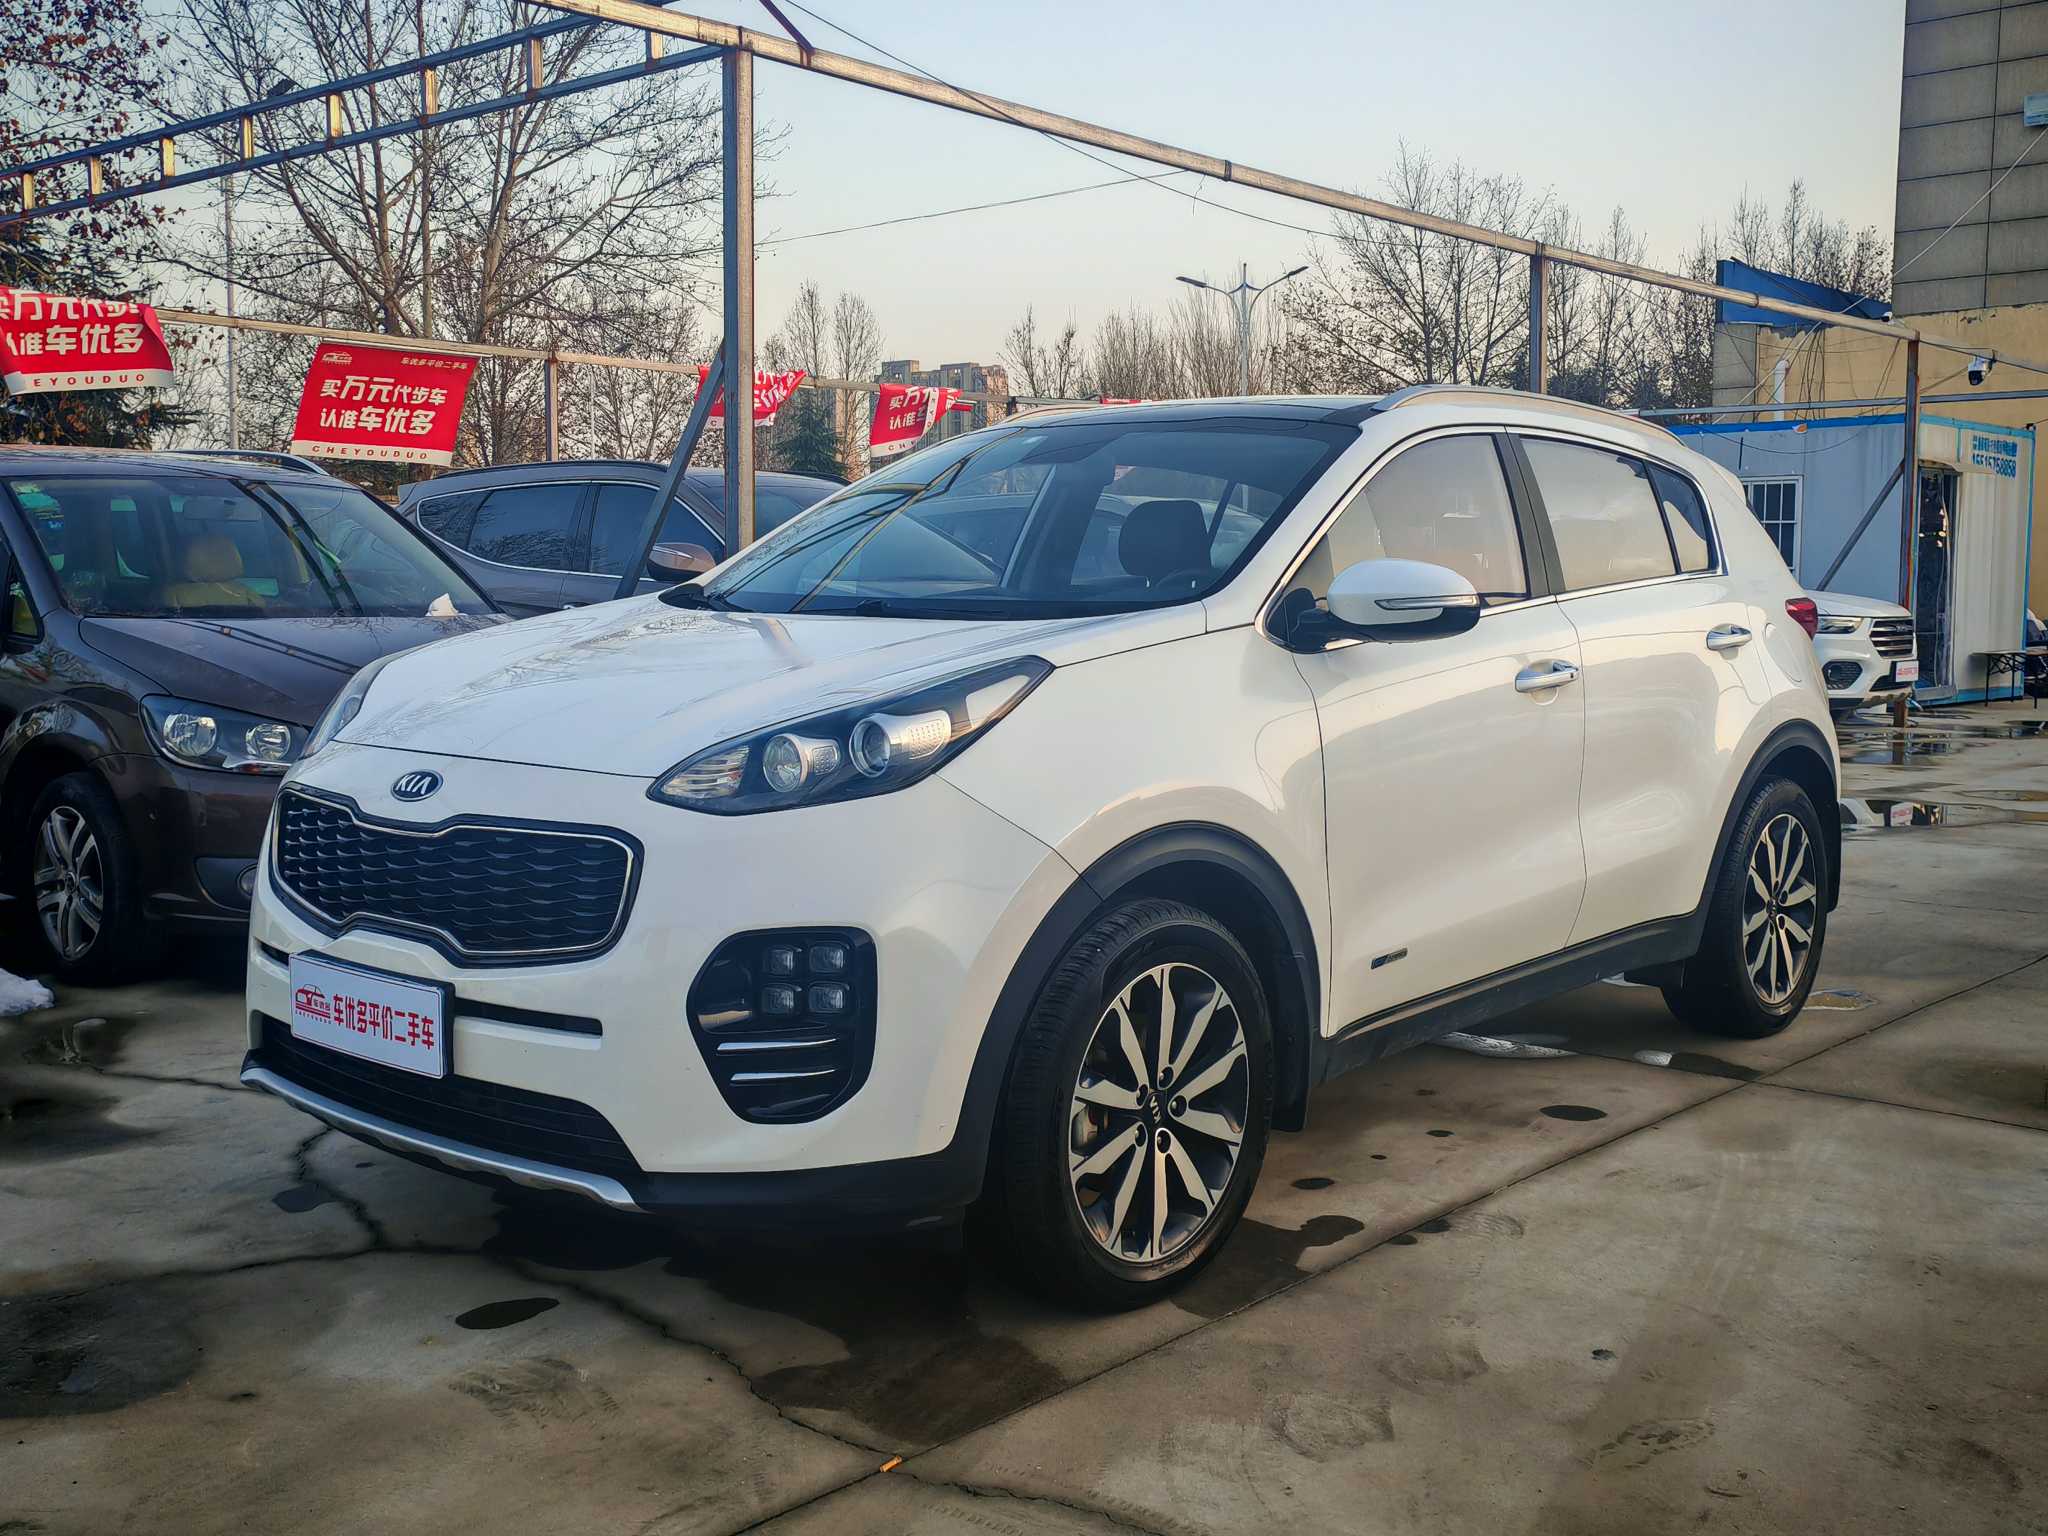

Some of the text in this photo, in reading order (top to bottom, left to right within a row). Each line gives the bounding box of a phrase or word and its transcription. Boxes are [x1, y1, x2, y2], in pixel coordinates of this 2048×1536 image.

[320, 375, 448, 406] 买万元代步车
[320, 405, 436, 435] 认准车优多
[312, 445, 427, 459] CHEYOUDUO
[395, 774, 432, 795] KIA
[333, 993, 435, 1050] 车优多平价二手车
